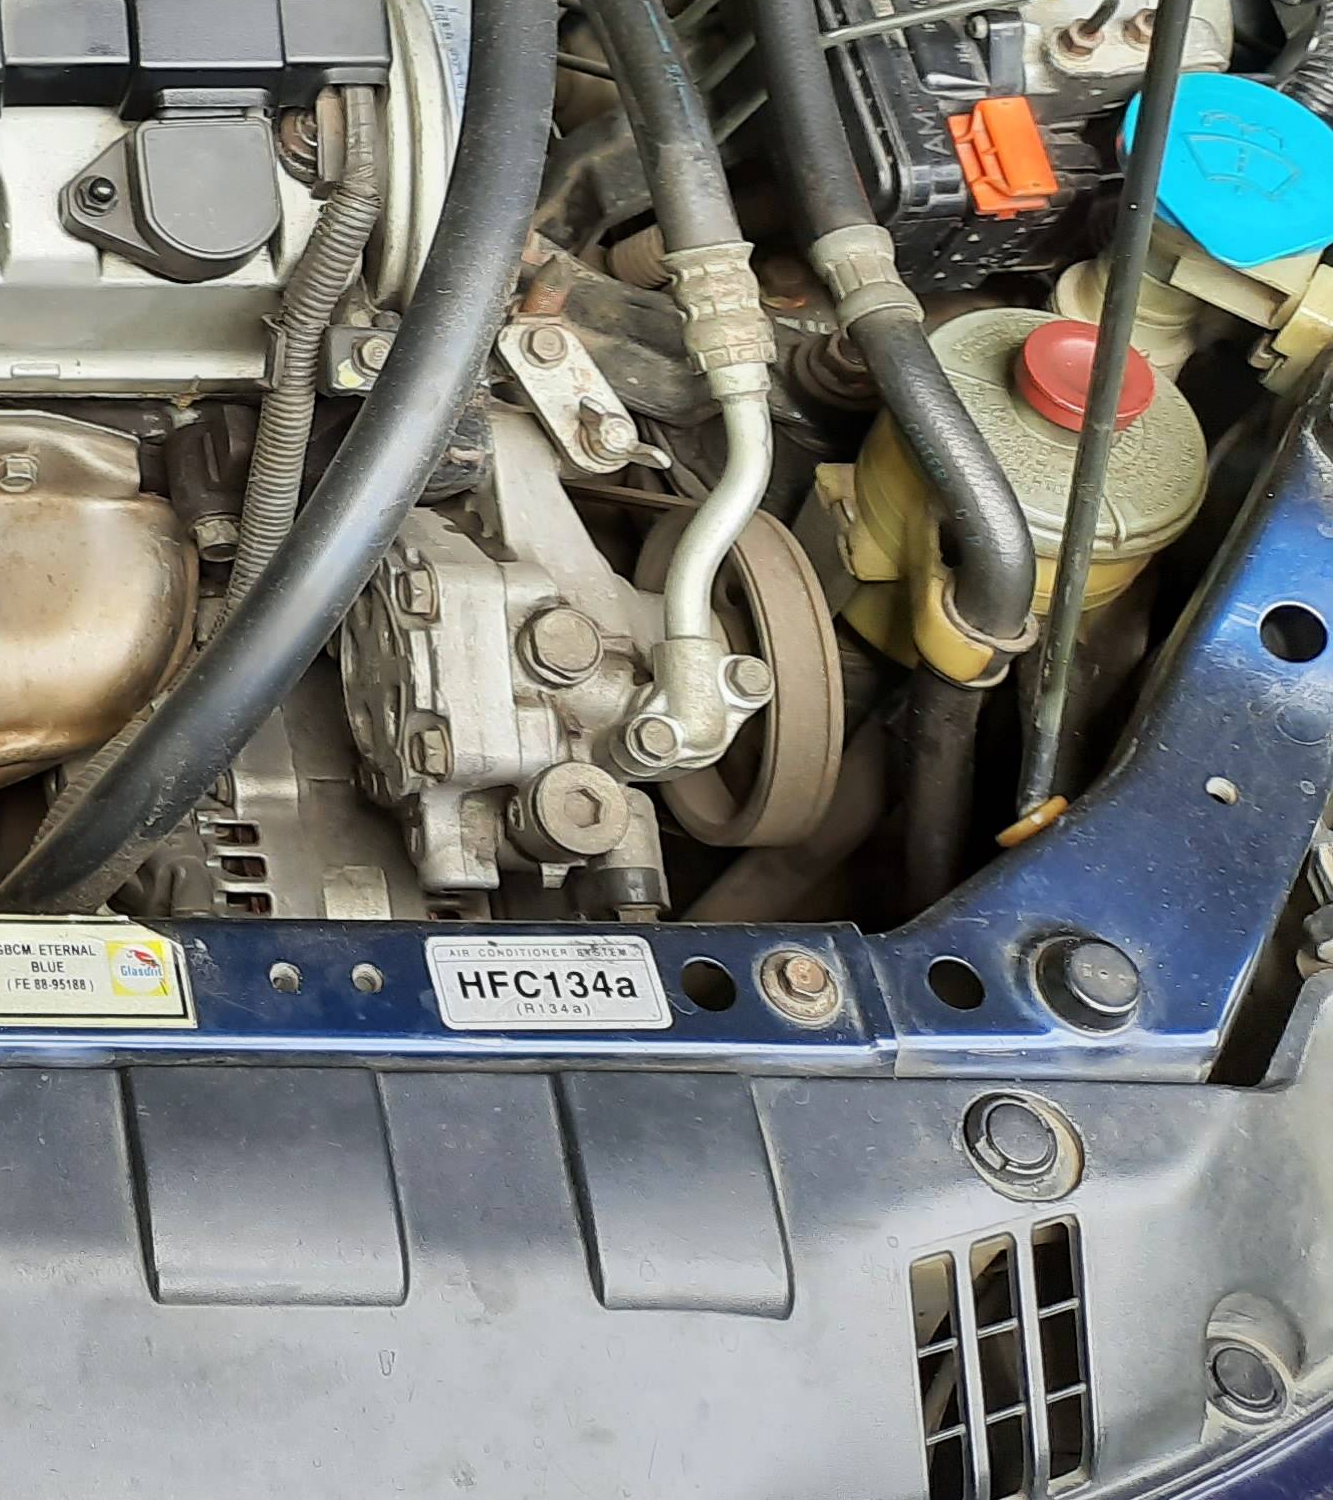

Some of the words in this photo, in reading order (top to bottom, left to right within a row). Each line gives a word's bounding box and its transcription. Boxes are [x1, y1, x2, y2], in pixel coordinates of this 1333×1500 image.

[38, 944, 96, 957] ETERNAL
[448, 948, 470, 957] AIR
[478, 948, 569, 958] CONDITIONER
[577, 947, 627, 957] SYSTEM
[30, 961, 65, 973] BLUE
[457, 970, 639, 1000] HFC134a
[516, 1003, 592, 1017] (R134a)
